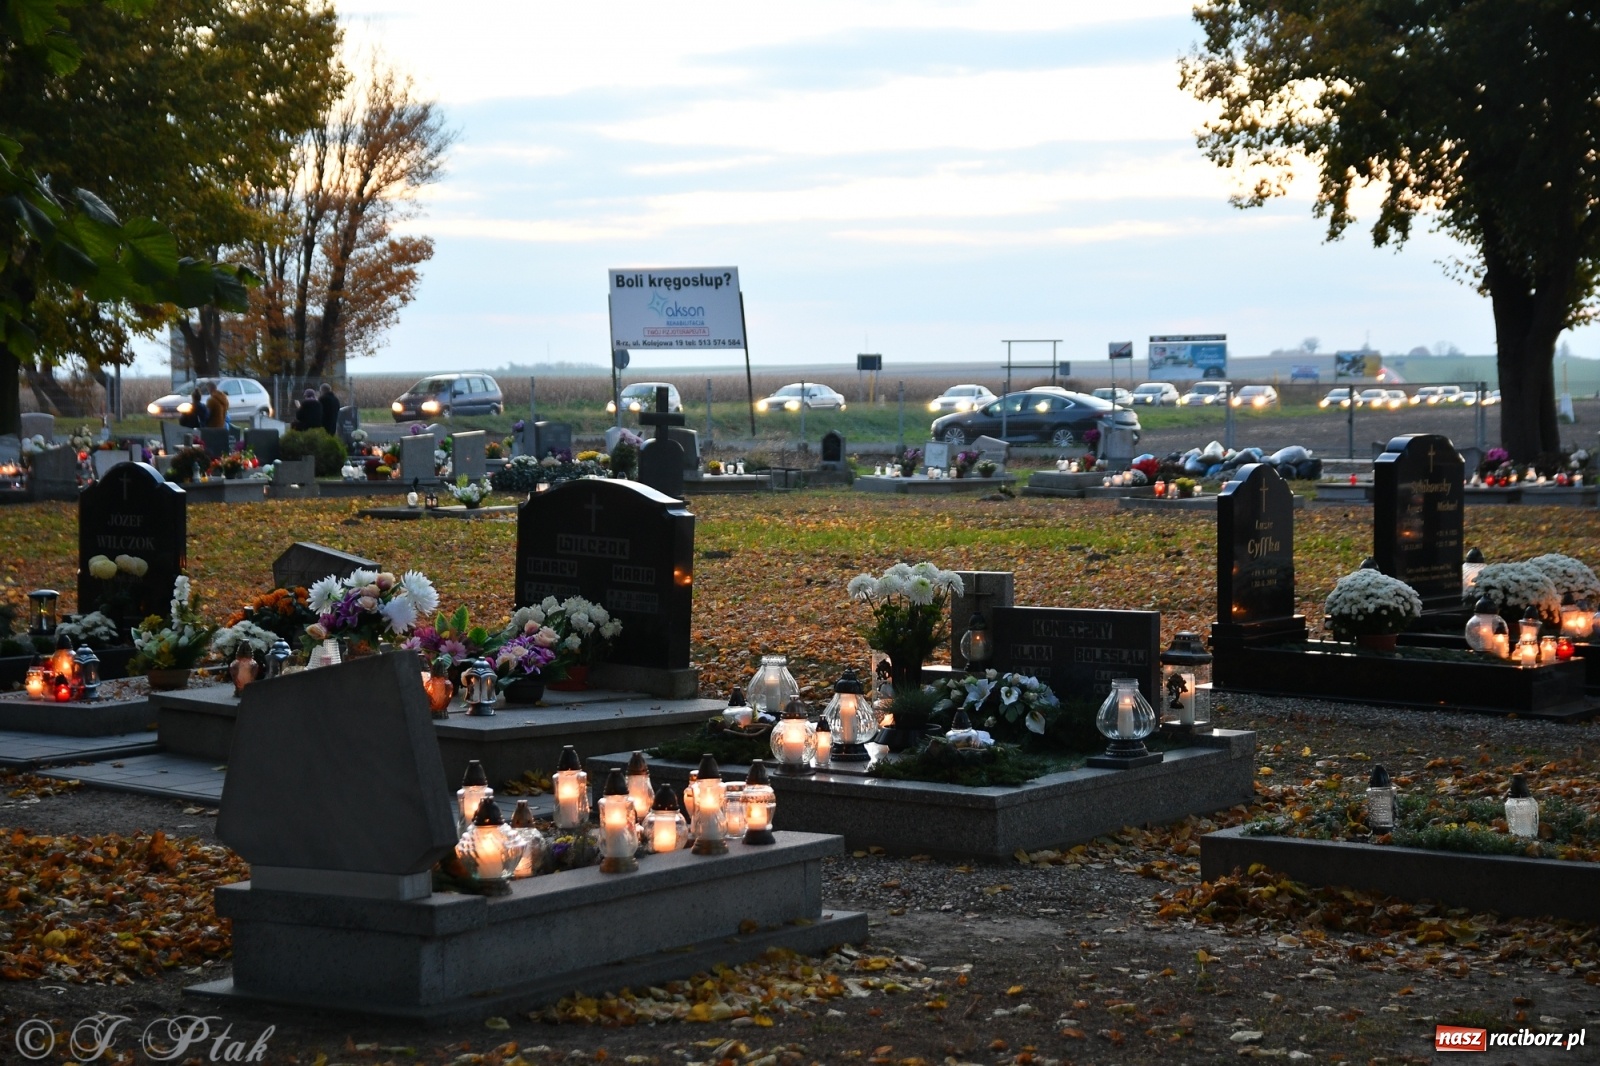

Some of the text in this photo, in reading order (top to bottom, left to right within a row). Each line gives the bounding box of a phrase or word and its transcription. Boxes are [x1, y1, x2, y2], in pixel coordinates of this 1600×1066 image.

[615, 272, 732, 290] Boli kręgosłup?
[665, 301, 705, 317] akson
[642, 339, 673, 347] Kolejowa
[107, 512, 144, 527] JÓZEF
[96, 534, 156, 551] WILCZOK
[558, 535, 627, 557] WILCZOK
[1247, 535, 1280, 559] Cyffka
[528, 558, 576, 577] IGNACY
[614, 565, 654, 583] MARIA
[1033, 619, 1113, 640] KONIECZNY
